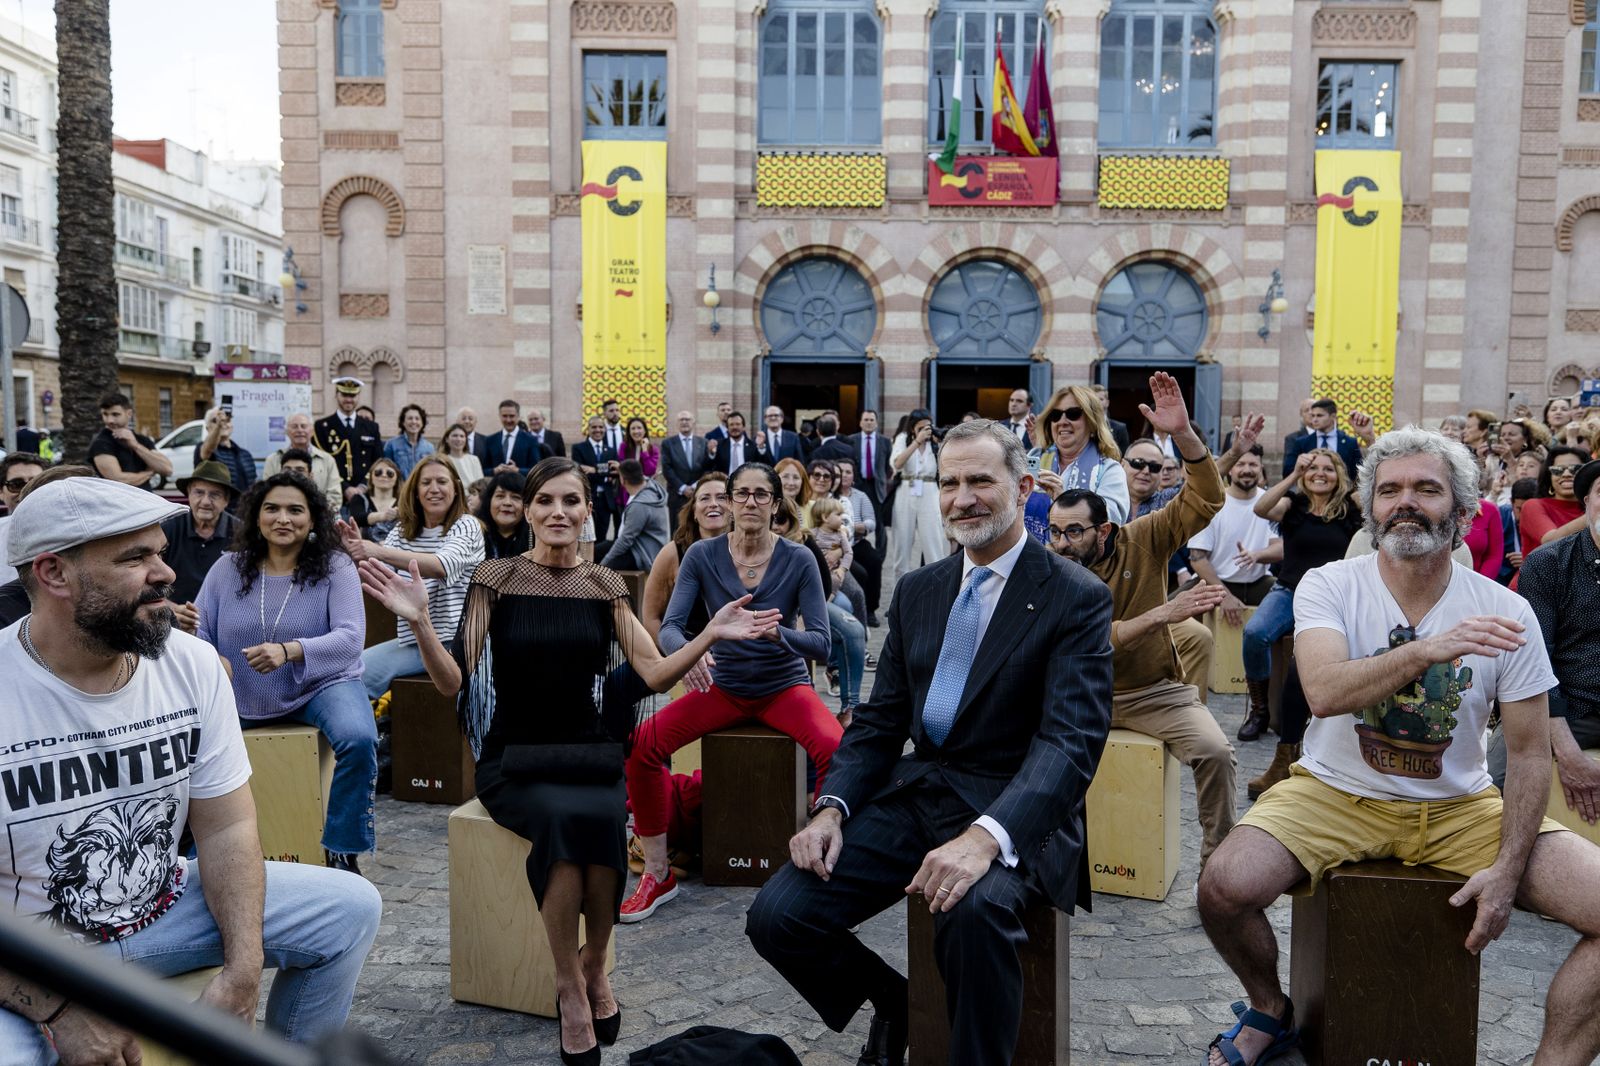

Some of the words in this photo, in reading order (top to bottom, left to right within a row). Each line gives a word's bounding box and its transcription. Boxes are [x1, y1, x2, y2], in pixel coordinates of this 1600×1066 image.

[987, 189, 1013, 200] CÁDIZ
[611, 258, 635, 266] GRAN
[609, 267, 640, 275] TEATRO
[241, 389, 285, 403] Fragela
[67, 730, 106, 743] GOTHAM
[107, 725, 128, 738] CITY
[128, 718, 156, 732] POLICE
[1361, 743, 1398, 768] FREE
[1403, 752, 1441, 774] HUGS
